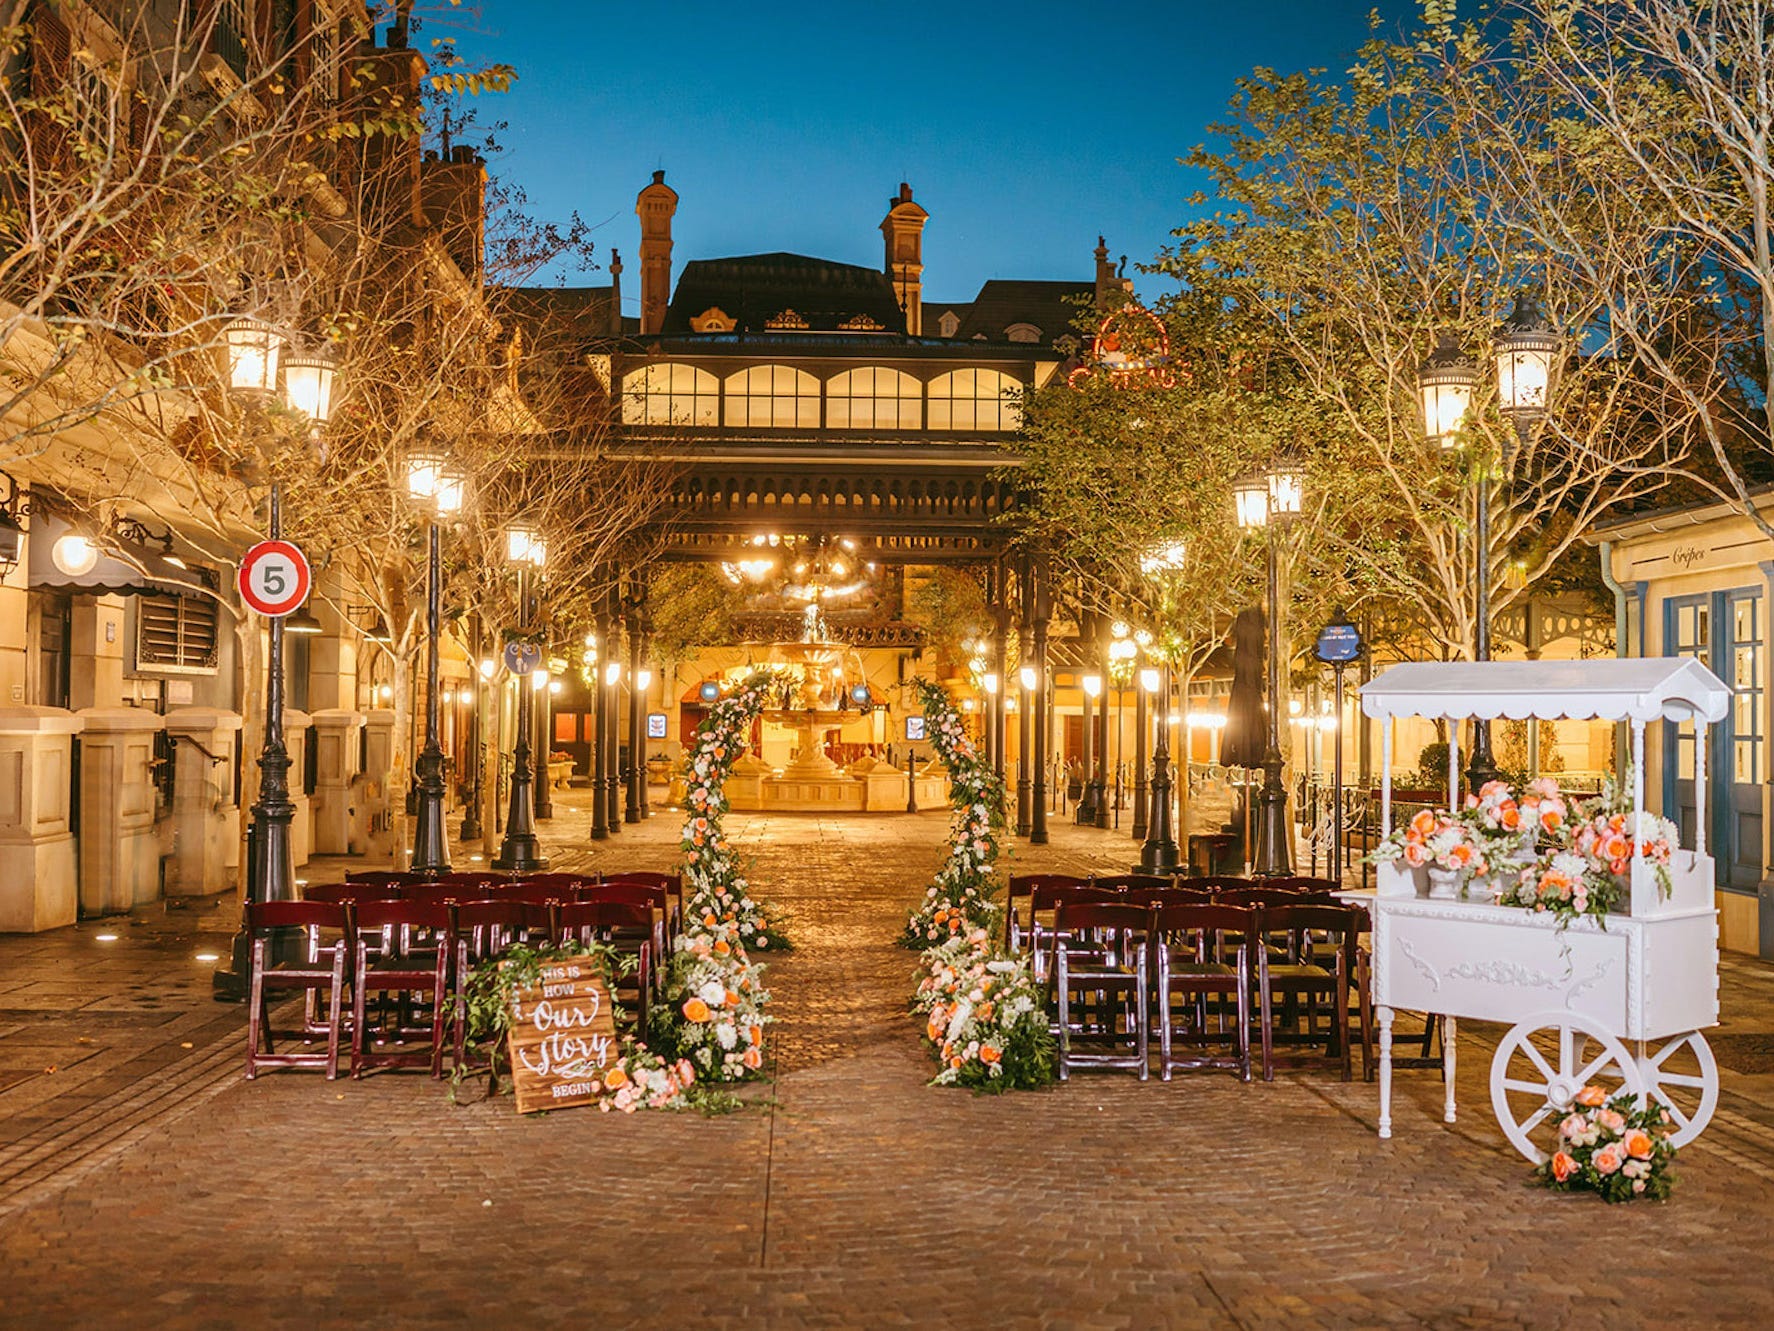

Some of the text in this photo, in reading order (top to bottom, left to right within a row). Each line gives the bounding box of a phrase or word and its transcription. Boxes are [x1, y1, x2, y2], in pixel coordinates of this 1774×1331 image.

[263, 566, 285, 595] 5
[541, 965, 581, 980] HIS IS
[543, 984, 575, 998] HOW
[525, 987, 600, 1031] Our
[519, 1031, 612, 1076] Story
[552, 1082, 592, 1098] BEGIN
